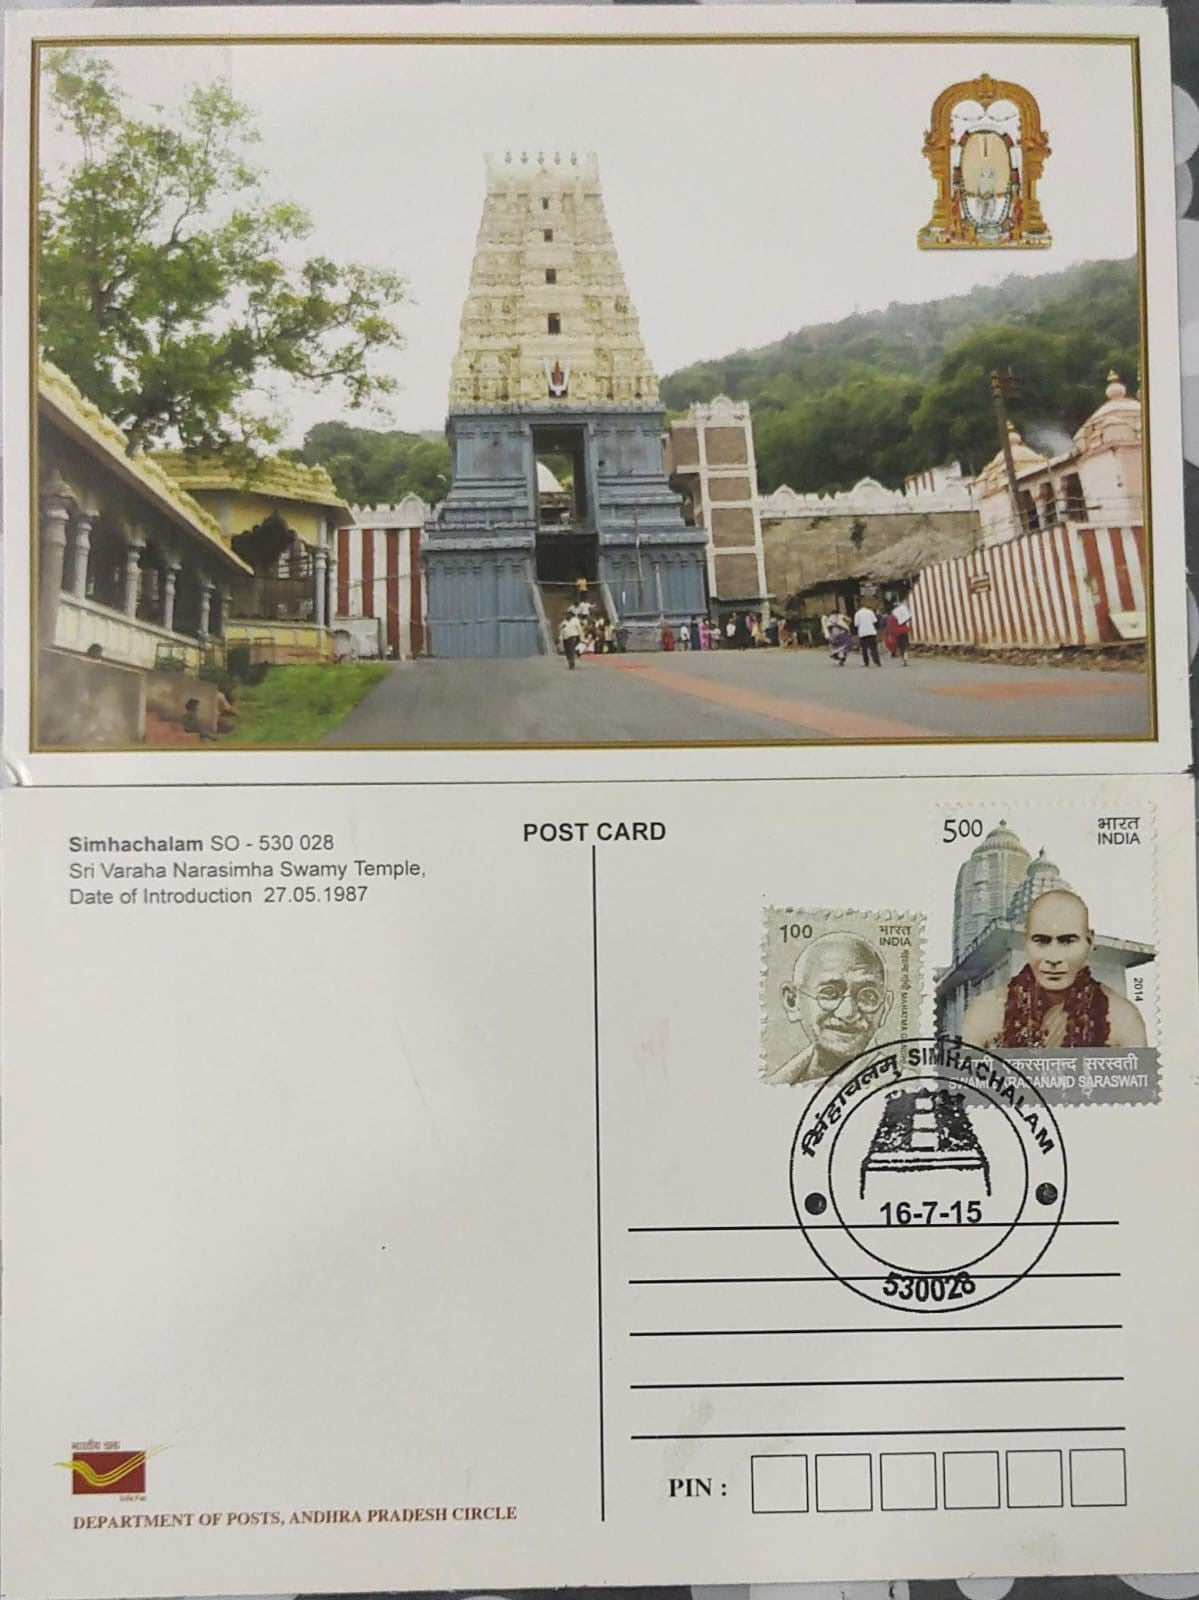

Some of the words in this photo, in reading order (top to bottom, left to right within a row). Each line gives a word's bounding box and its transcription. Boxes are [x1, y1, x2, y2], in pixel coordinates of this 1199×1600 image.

[523, 822, 590, 843] POST
[596, 821, 667, 842] CARD
[1097, 816, 1141, 831] भारत
[69, 835, 204, 853] Simhachalam
[210, 834, 240, 852] SO
[258, 834, 294, 852] 530
[299, 833, 335, 851] 028
[1097, 832, 1142, 846] INDIA
[69, 862, 95, 880] Sri
[99, 862, 167, 879] Varaha
[173, 861, 274, 879] Narasimha
[279, 860, 348, 883] Swamy
[353, 859, 426, 883] Temple,
[69, 888, 114, 905] Date
[119, 887, 138, 905] of
[143, 887, 253, 905] Introduction
[263, 885, 369, 904] 27.05.1987
[878, 924, 912, 937] भारत
[879, 936, 912, 947] INDIA
[1133, 977, 1144, 1002] 2014
[1082, 1052, 1139, 1071] सरस्वती
[1078, 1074, 1149, 1089] SARASWATI
[908, 1046, 1056, 1155] SIMHACHALAM
[879, 1199, 983, 1225] 16-7-15
[882, 1270, 977, 1303] 530028
[668, 1477, 713, 1498] PIN
[73, 1513, 195, 1530] DEPARTMENT
[198, 1512, 223, 1528] OF
[226, 1511, 286, 1528] POSTS,
[288, 1509, 363, 1525] ANDHRA
[366, 1507, 448, 1523] PRADESH
[451, 1506, 518, 1521] CIRCLE
